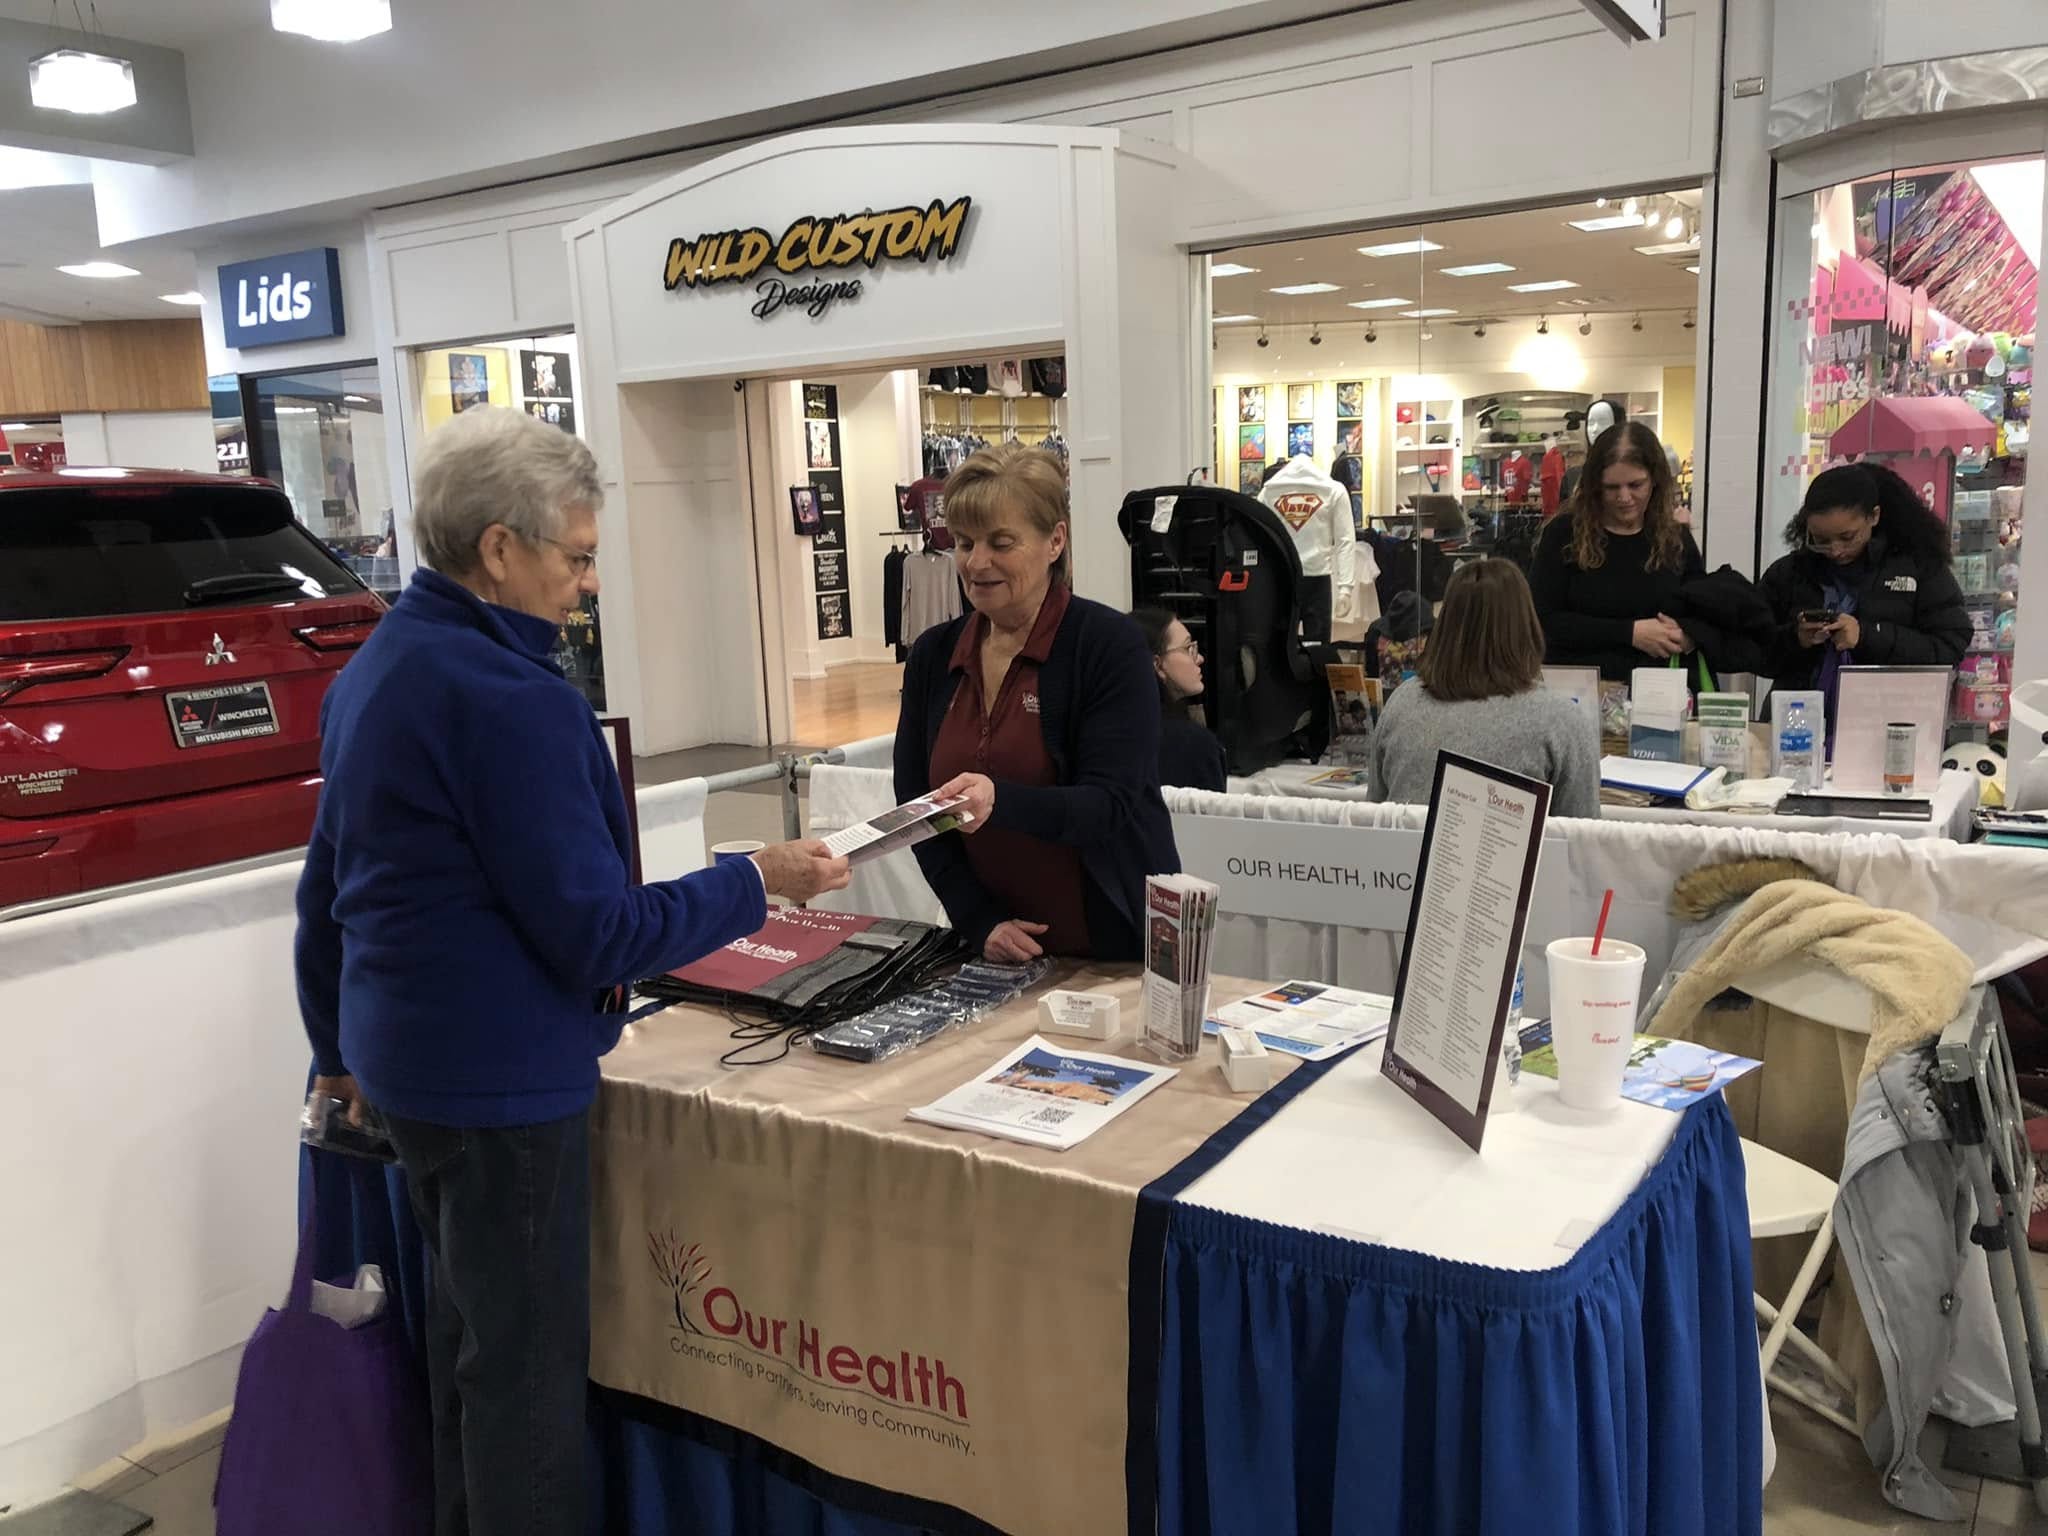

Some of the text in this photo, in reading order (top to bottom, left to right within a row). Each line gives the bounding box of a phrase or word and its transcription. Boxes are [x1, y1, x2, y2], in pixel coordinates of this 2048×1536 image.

[664, 196, 971, 289] WILD CUSTOM
[238, 272, 312, 327] Lids
[751, 277, 862, 319] Designs
[217, 707, 268, 721] WINCHESTER
[195, 725, 273, 743] MITSUBISHI MOTORS
[1632, 749, 1656, 759] VDH
[0, 768, 78, 784] UTLANDER
[1227, 857, 1412, 891] OUR HEALTH, INC
[733, 937, 758, 950] Our
[755, 944, 797, 960] Health
[703, 1287, 968, 1419] Our Health
[670, 1336, 754, 1379] Connecting
[808, 1391, 868, 1425] Serving
